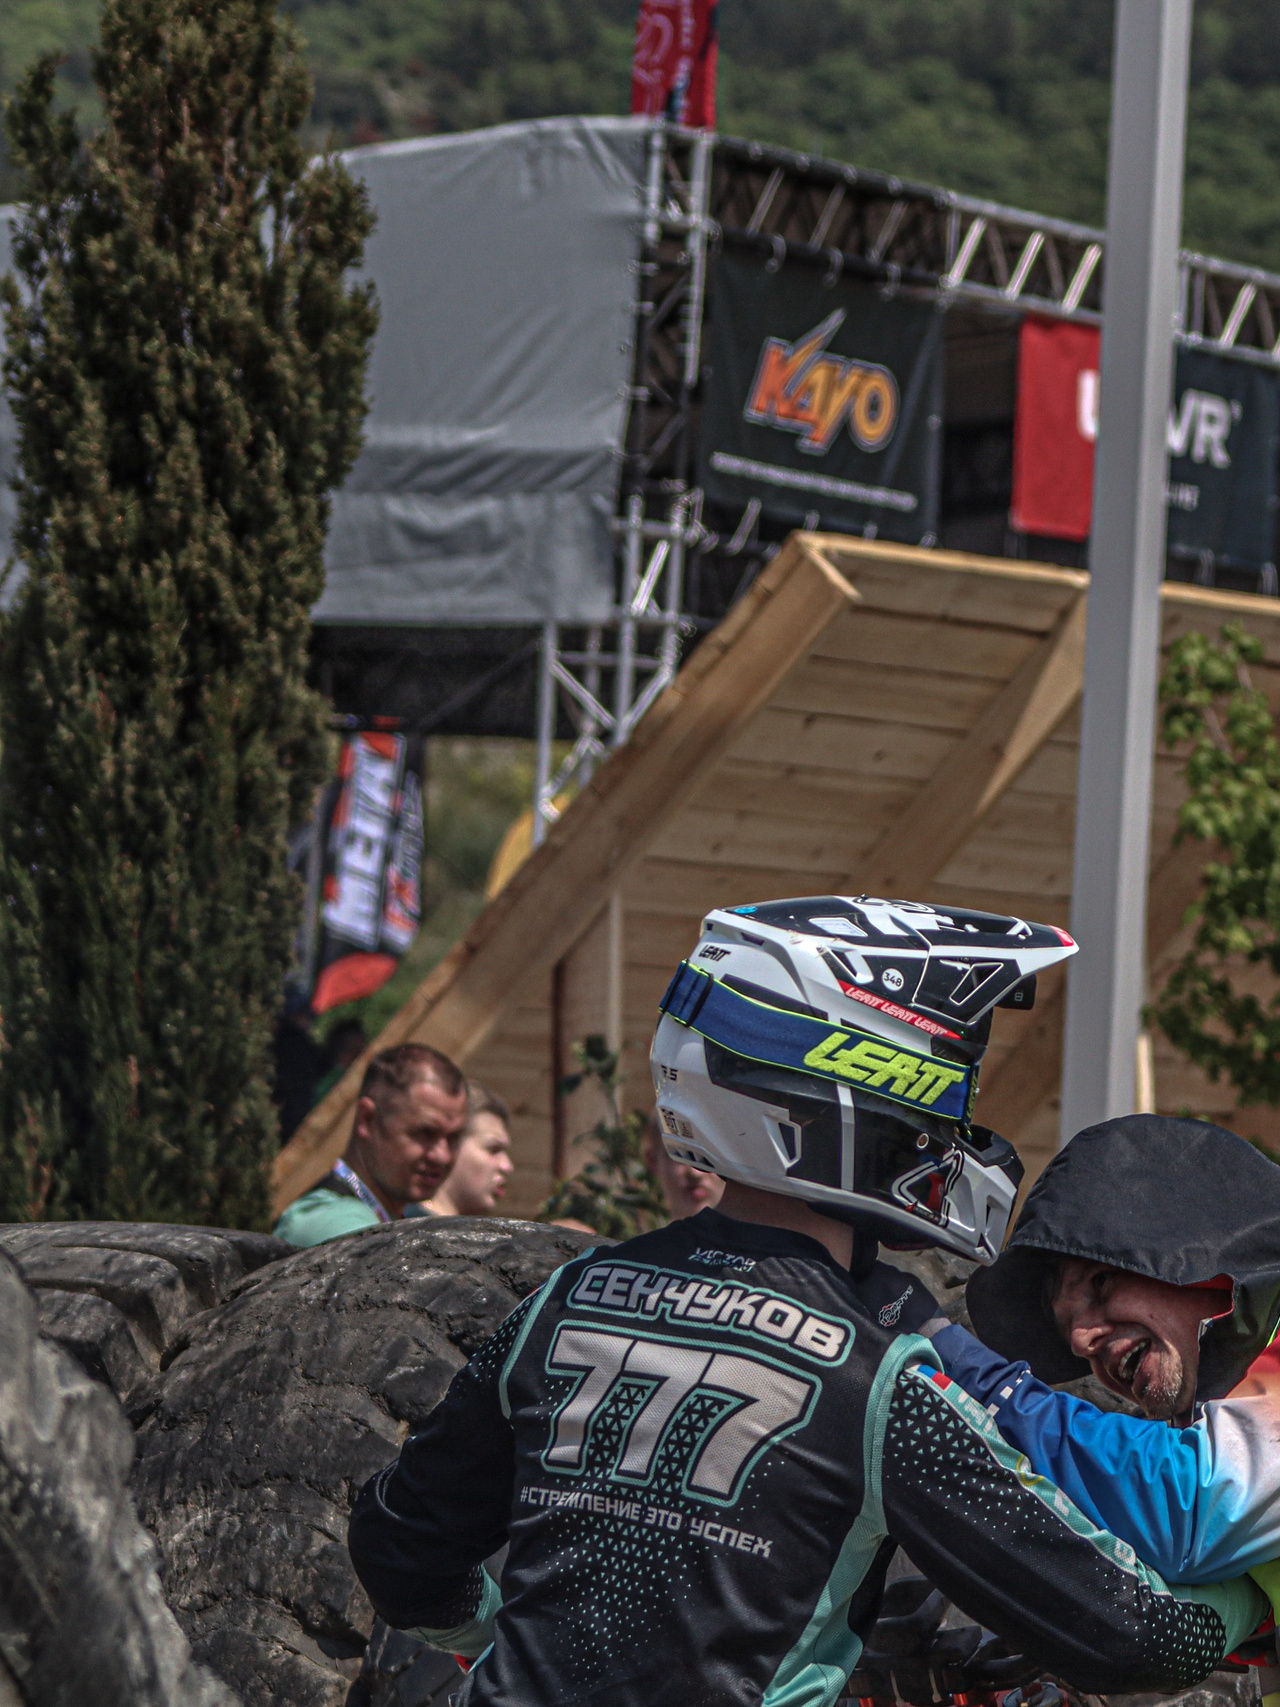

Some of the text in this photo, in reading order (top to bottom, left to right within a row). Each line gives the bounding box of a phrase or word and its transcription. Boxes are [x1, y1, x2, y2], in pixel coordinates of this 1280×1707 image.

[744, 309, 899, 455] KAYO
[698, 944, 731, 962] LEATT
[883, 971, 902, 987] 348
[844, 986, 949, 1037] LEATT LEATT LEATT
[804, 1031, 966, 1106] LEATT
[574, 1266, 846, 1359] СЕНЧУКОВ
[548, 1328, 813, 1499] 777
[520, 1486, 774, 1559] #СТРЕМЛЕНИЕ ЭТО УСПЕХ
